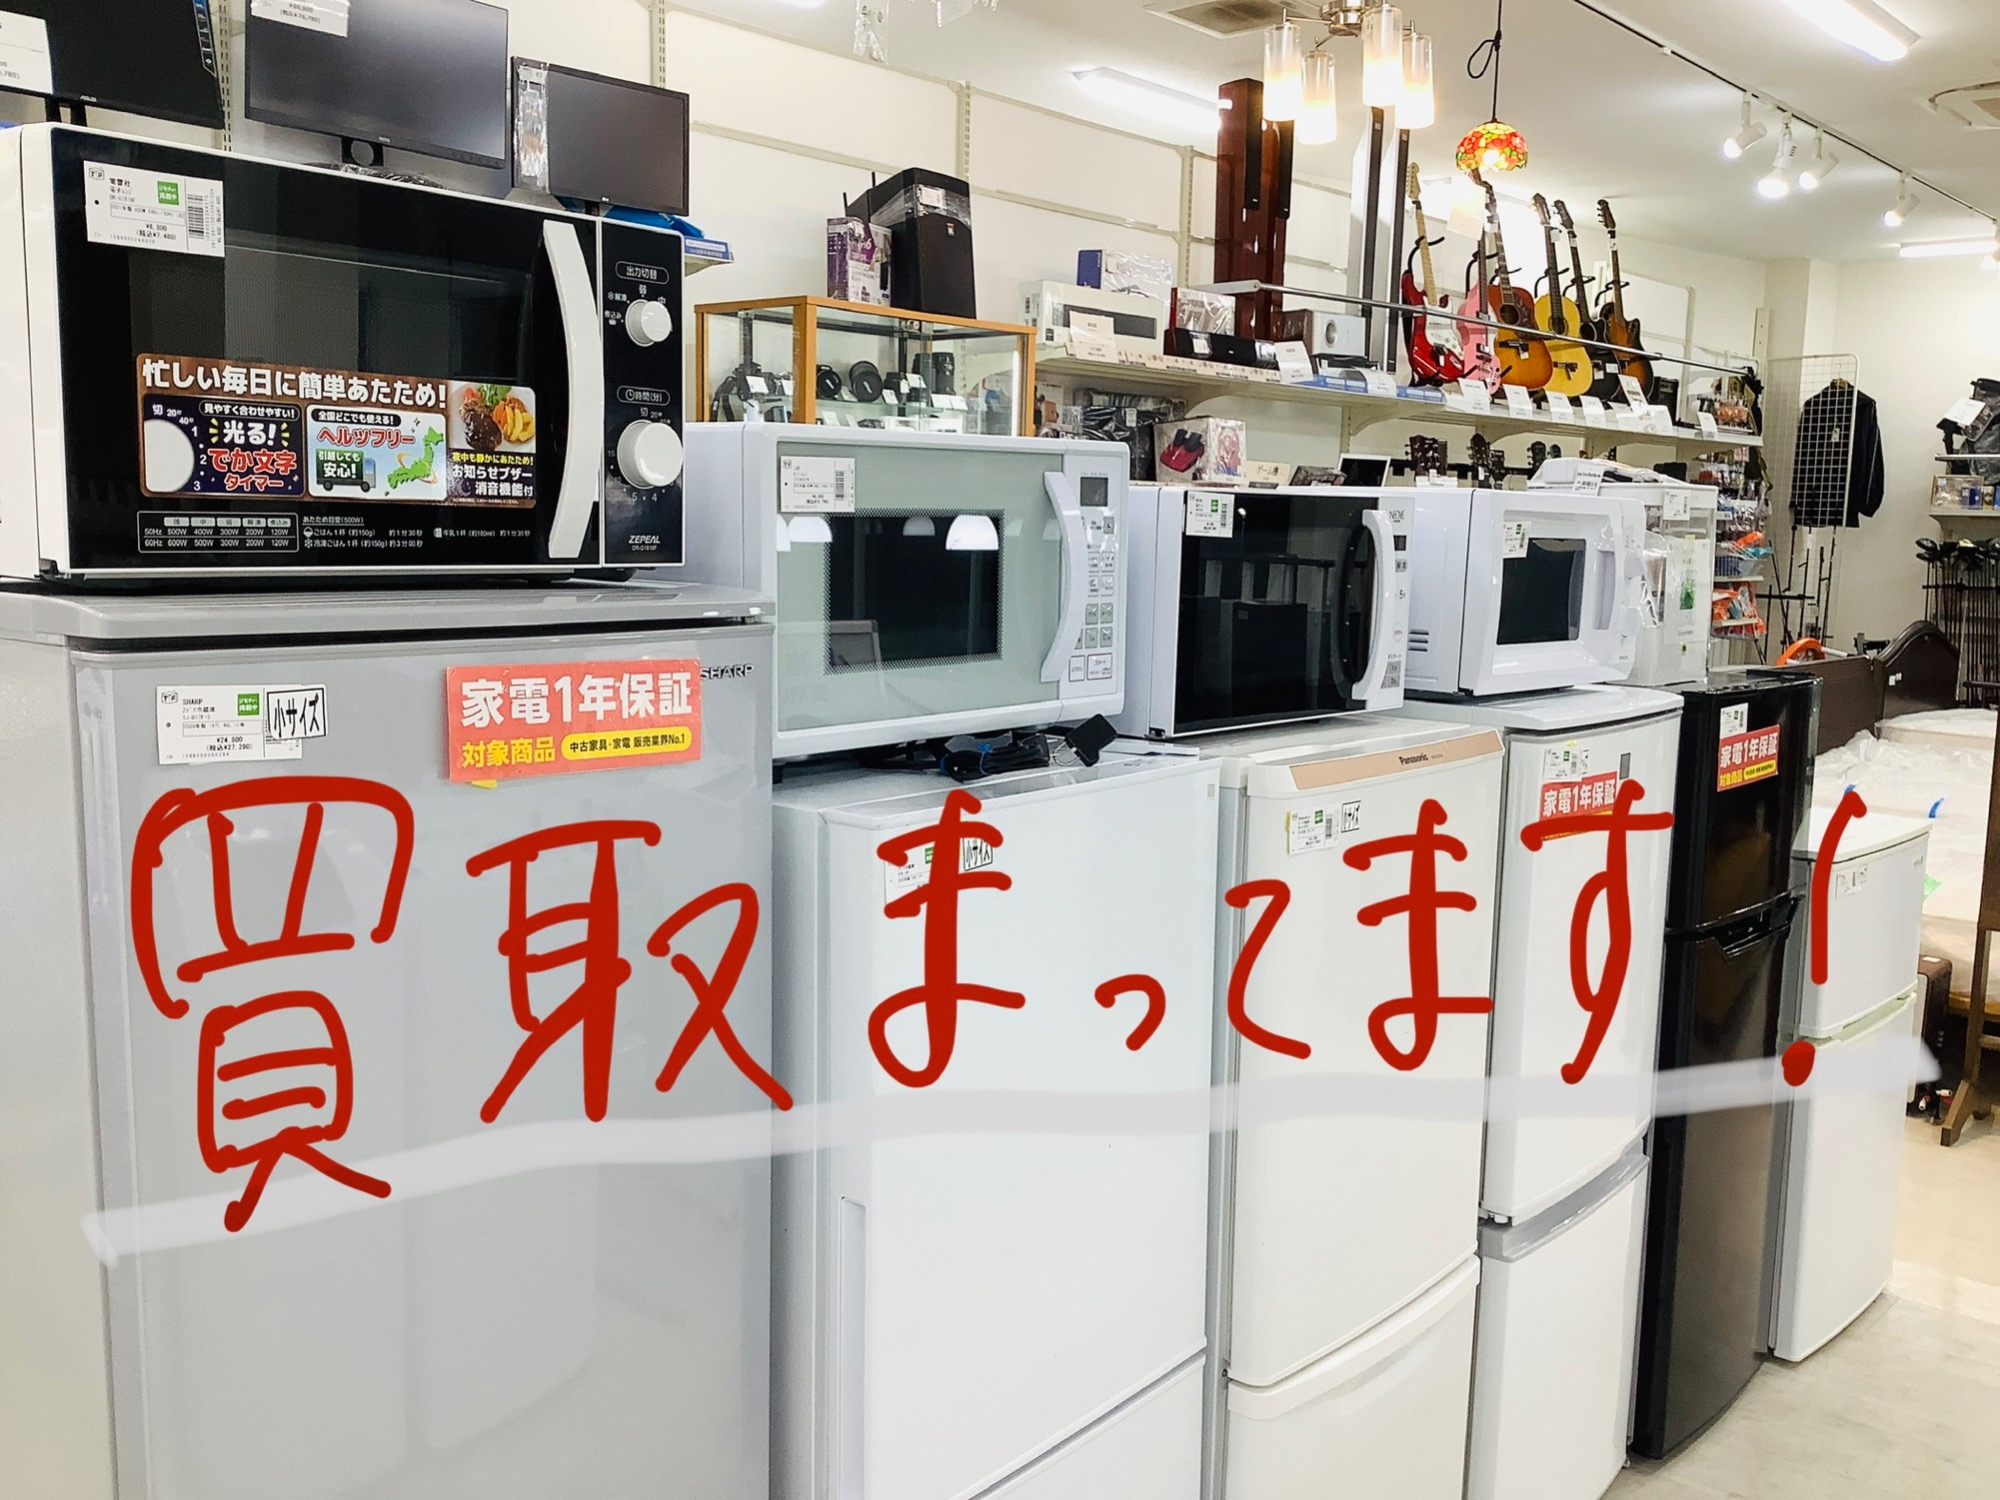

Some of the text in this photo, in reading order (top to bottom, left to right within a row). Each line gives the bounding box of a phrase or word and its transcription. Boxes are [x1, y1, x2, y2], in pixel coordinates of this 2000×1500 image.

[142, 358, 447, 409] 忙しい毎日に簡単あたため!
[152, 403, 163, 416] 切
[204, 402, 295, 419] 見やすく合わせやすい!
[318, 410, 395, 426] 全国どこでも使える!
[191, 426, 198, 437] 1
[223, 420, 277, 446] 光る!
[317, 426, 416, 450] ヘルツフリー
[200, 454, 207, 465] 2
[208, 448, 297, 475] でか文字
[318, 451, 361, 462] 引越しても
[452, 452, 534, 466] 夜中も静かにあたため!
[323, 463, 357, 479] 安心!
[452, 464, 533, 480] お知らせブザー
[193, 481, 201, 491] 3
[224, 474, 284, 492] タイマー
[475, 480, 533, 497] 消音機能付
[651, 493, 658, 502] 4
[144, 528, 163, 536] 50Hz
[167, 528, 187, 536] 500W
[193, 528, 214, 536] 400W
[220, 528, 240, 536] 300W
[628, 535, 661, 544] ZEPEAL
[220, 539, 240, 547] 300W
[245, 539, 264, 547] 200W
[271, 539, 289, 547] 120W
[700, 664, 755, 681] SHARP
[182, 698, 204, 706] SHARP
[461, 671, 693, 729] 家電1年保証
[273, 692, 320, 739] 小サイズ
[633, 732, 685, 749] 販売業界No.1
[461, 736, 557, 769] 対象商品
[1720, 732, 1779, 769] 家電1年保証
[1398, 753, 1429, 766] Panasonic
[1543, 778, 1616, 818] 家電1年保証
